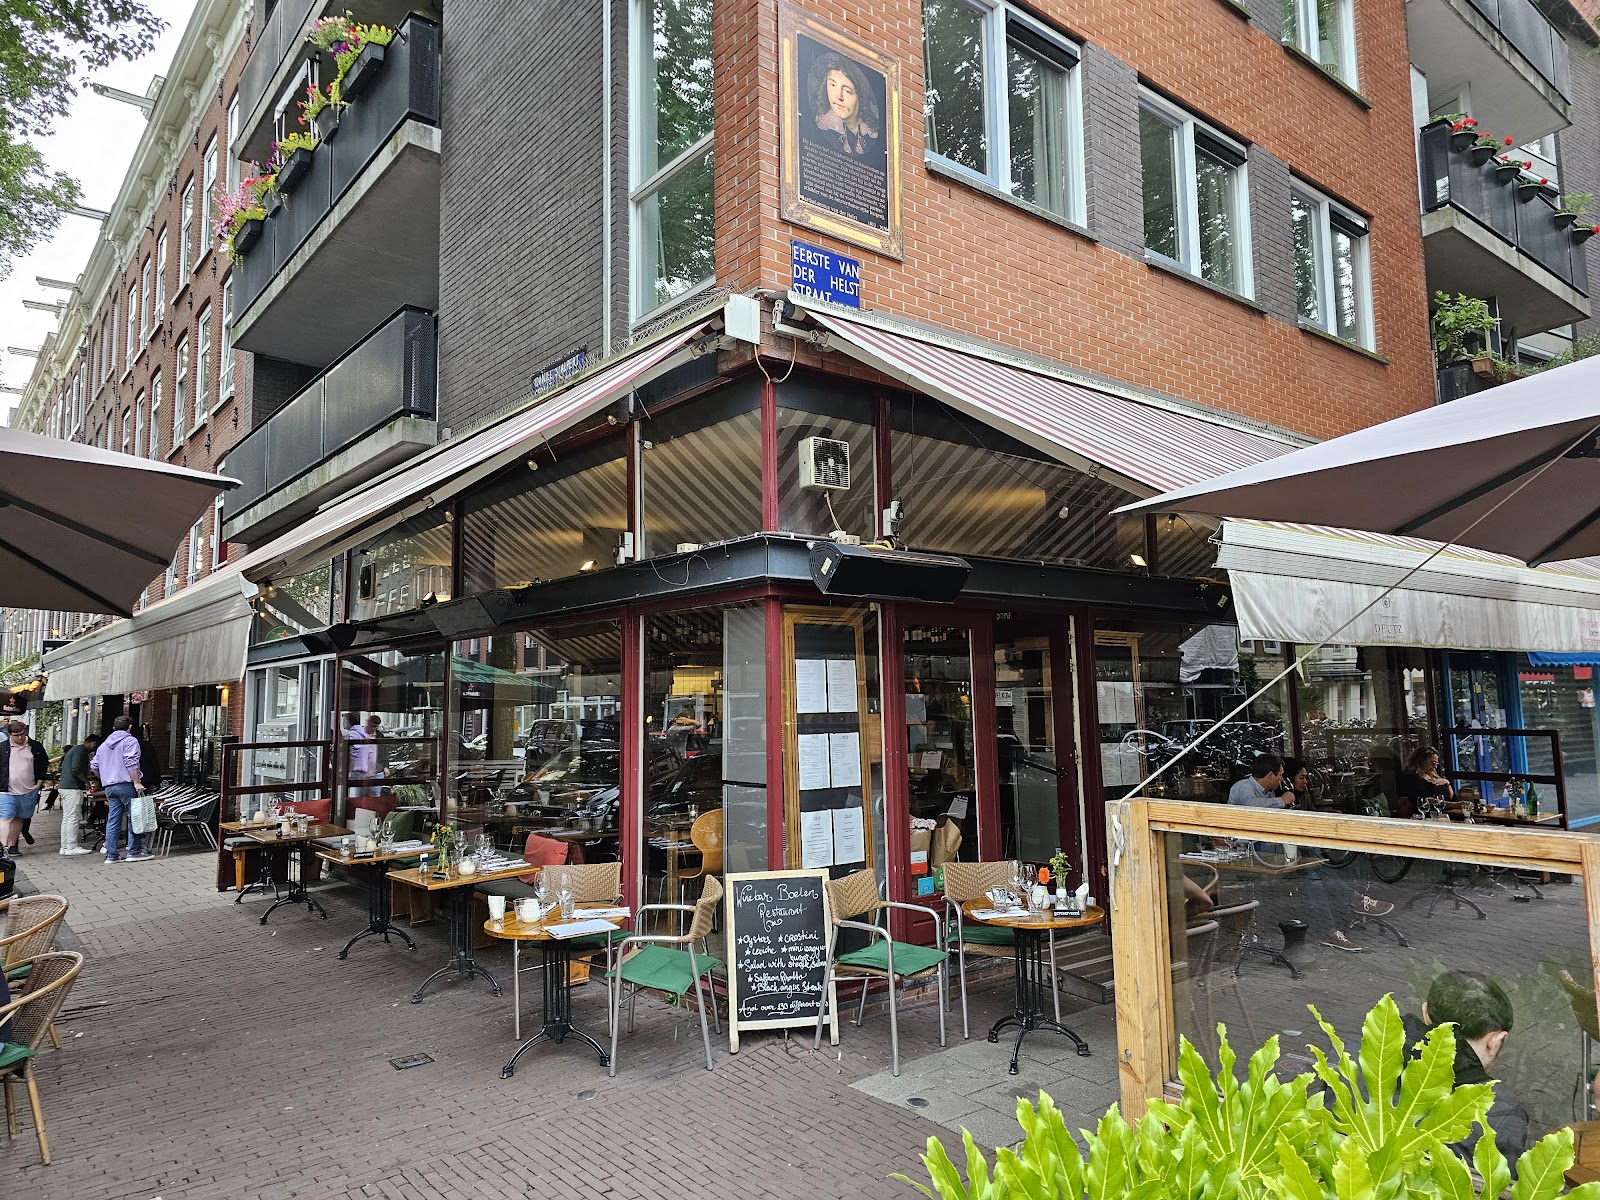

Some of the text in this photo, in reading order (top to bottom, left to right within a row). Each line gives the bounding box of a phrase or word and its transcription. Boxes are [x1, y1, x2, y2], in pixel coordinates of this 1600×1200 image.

[793, 245, 860, 280] EERSTE VAN
[793, 263, 860, 297] DER HELST
[793, 282, 832, 303] STRAAT
[1374, 623, 1403, 634] DEUTZ
[776, 883, 819, 900] Boelen
[744, 958, 767, 972] Salad
[768, 957, 786, 969] with
